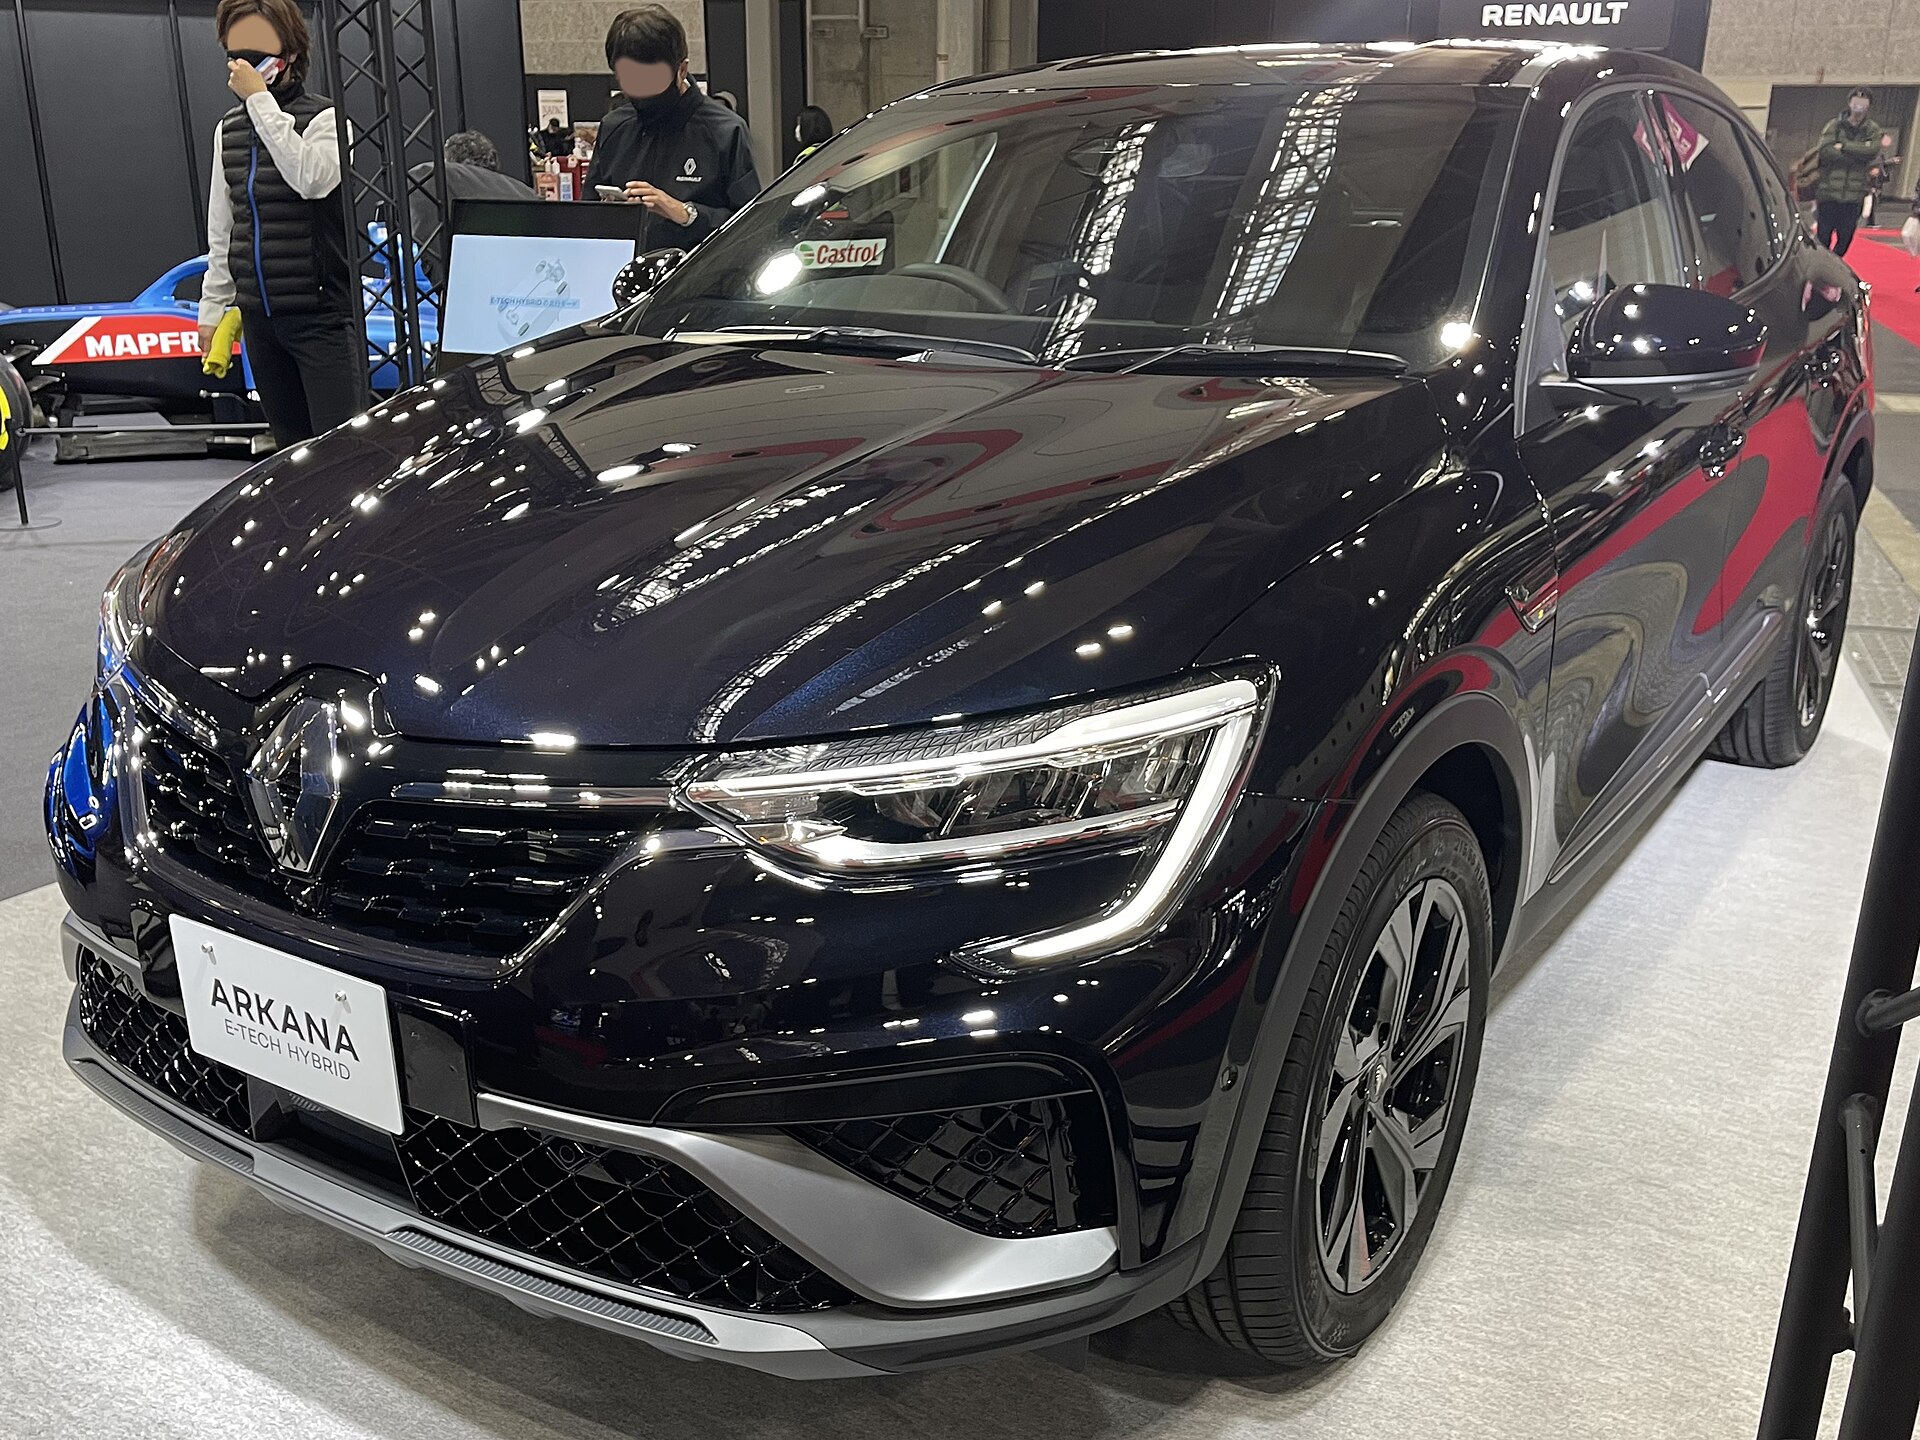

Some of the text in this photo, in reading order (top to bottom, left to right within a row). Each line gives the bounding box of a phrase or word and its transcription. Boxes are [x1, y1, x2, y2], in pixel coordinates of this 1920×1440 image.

[1481, 1, 1629, 27] RENAULT
[816, 242, 879, 265] Castrol
[84, 330, 201, 358] MAPFR
[210, 977, 360, 1062] ARKANA
[224, 1018, 351, 1081] E-TECH HYBRID
